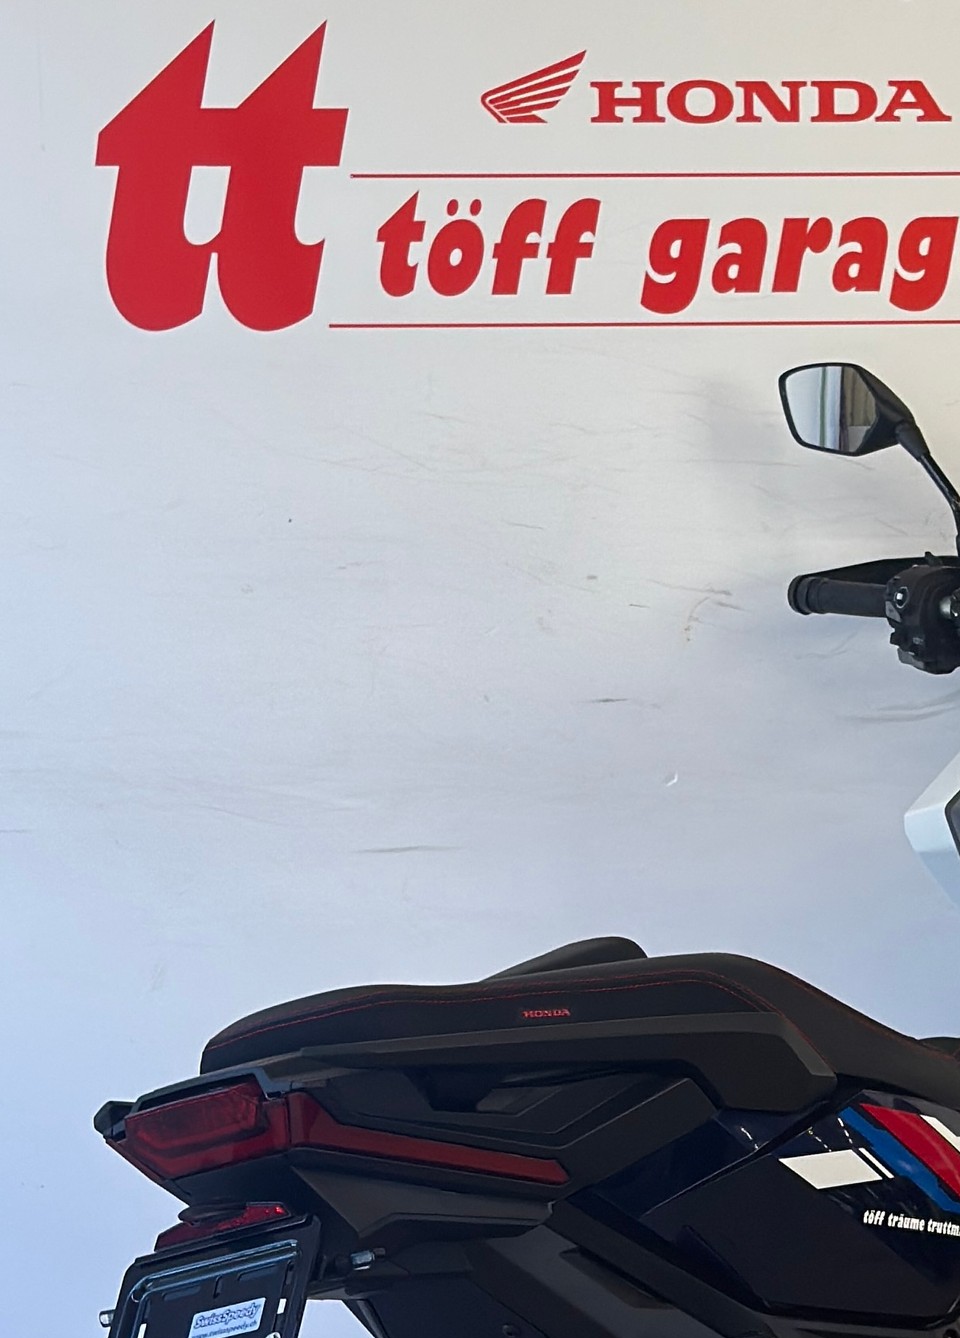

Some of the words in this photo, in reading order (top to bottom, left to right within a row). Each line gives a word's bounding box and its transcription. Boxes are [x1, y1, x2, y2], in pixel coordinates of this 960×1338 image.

[590, 80, 952, 124] HONDA
[376, 191, 601, 297] töff
[521, 1008, 571, 1018] HONDA
[863, 1210, 886, 1226] töff
[887, 1213, 925, 1231] träume
